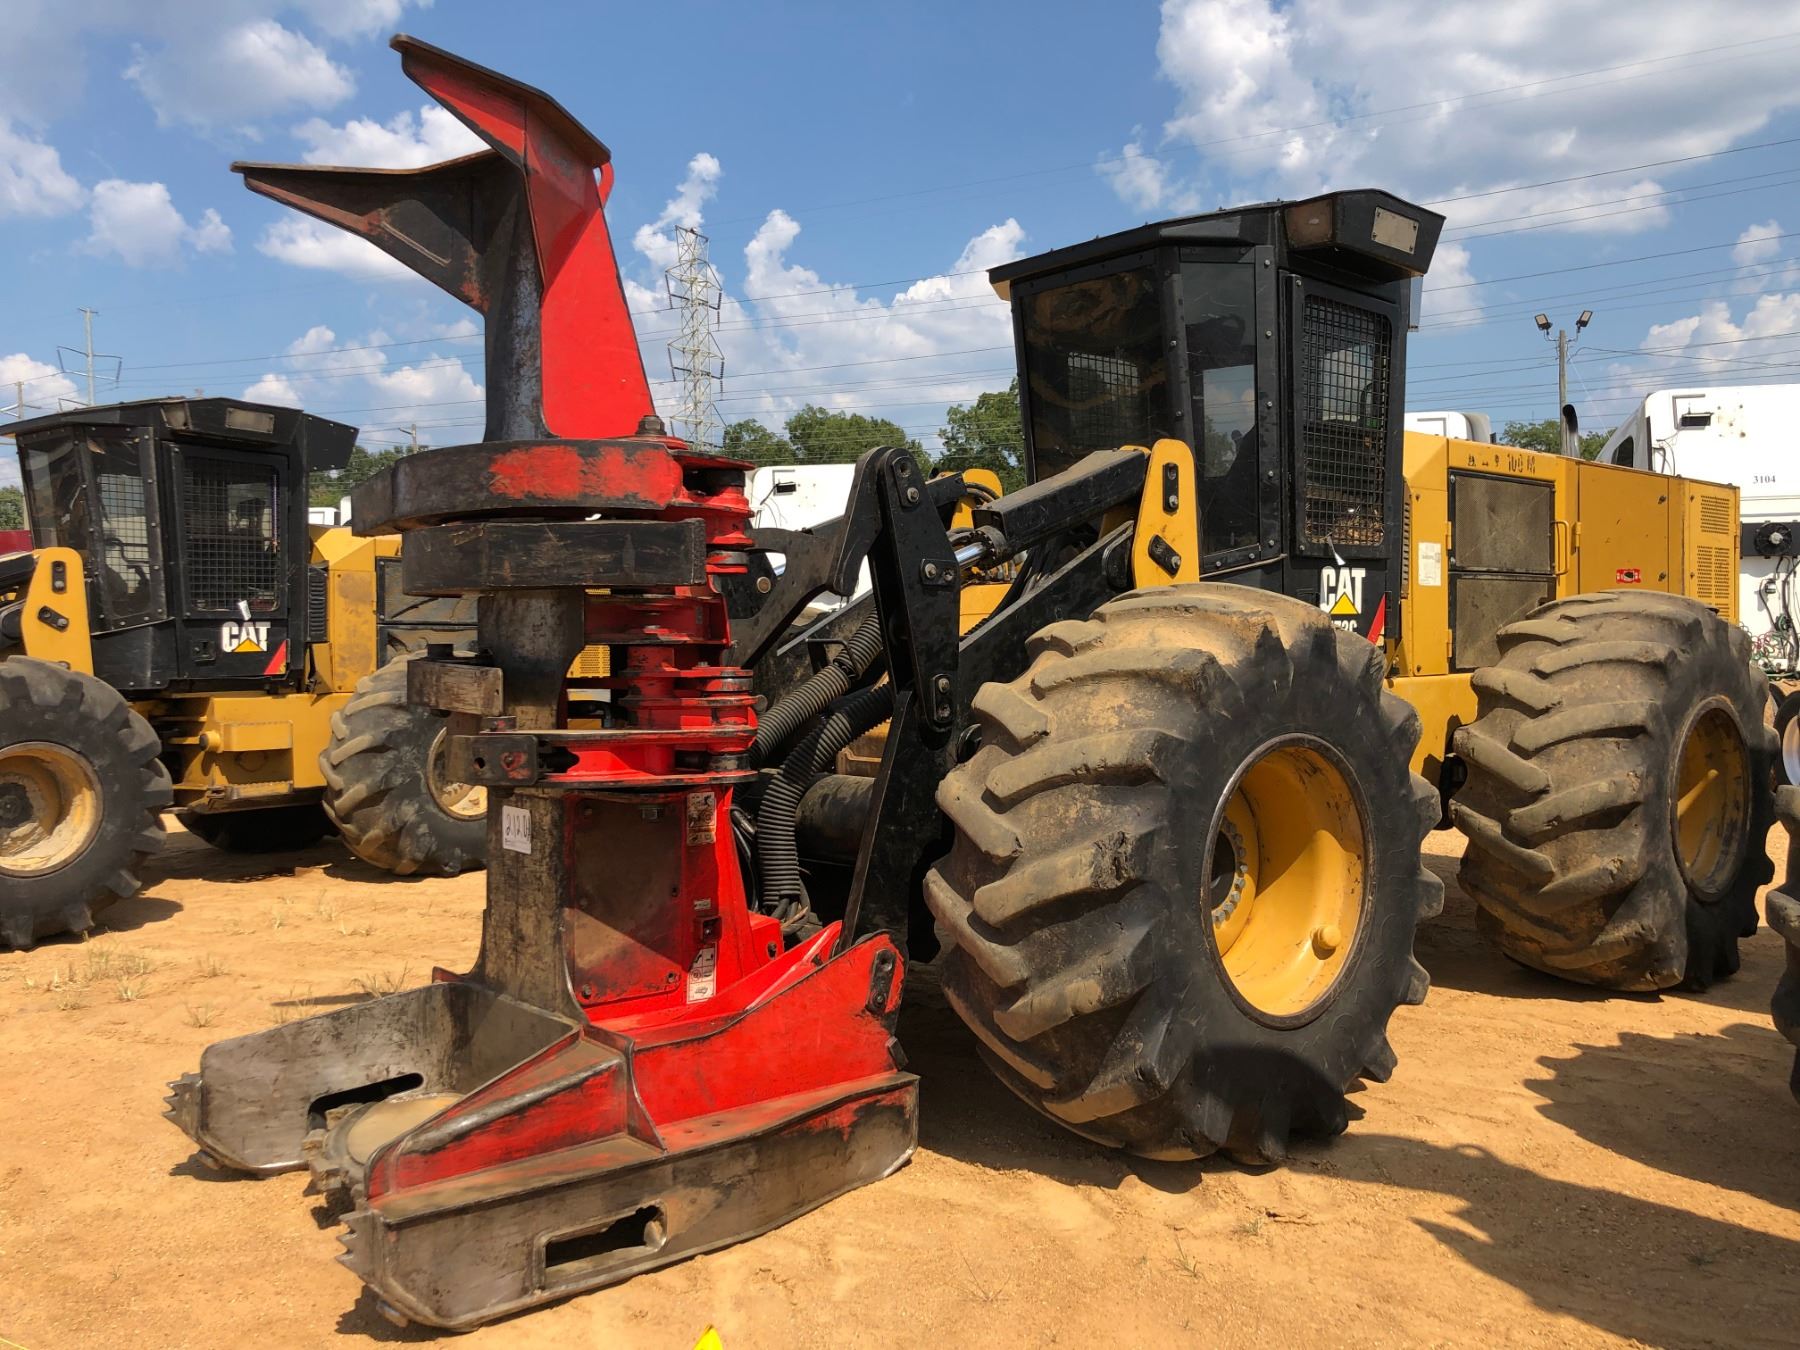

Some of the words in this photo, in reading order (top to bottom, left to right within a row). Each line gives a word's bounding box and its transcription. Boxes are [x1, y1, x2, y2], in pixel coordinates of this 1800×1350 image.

[1752, 475, 1776, 485] 3104
[1320, 565, 1366, 614] CAT
[222, 621, 271, 653] CAT
